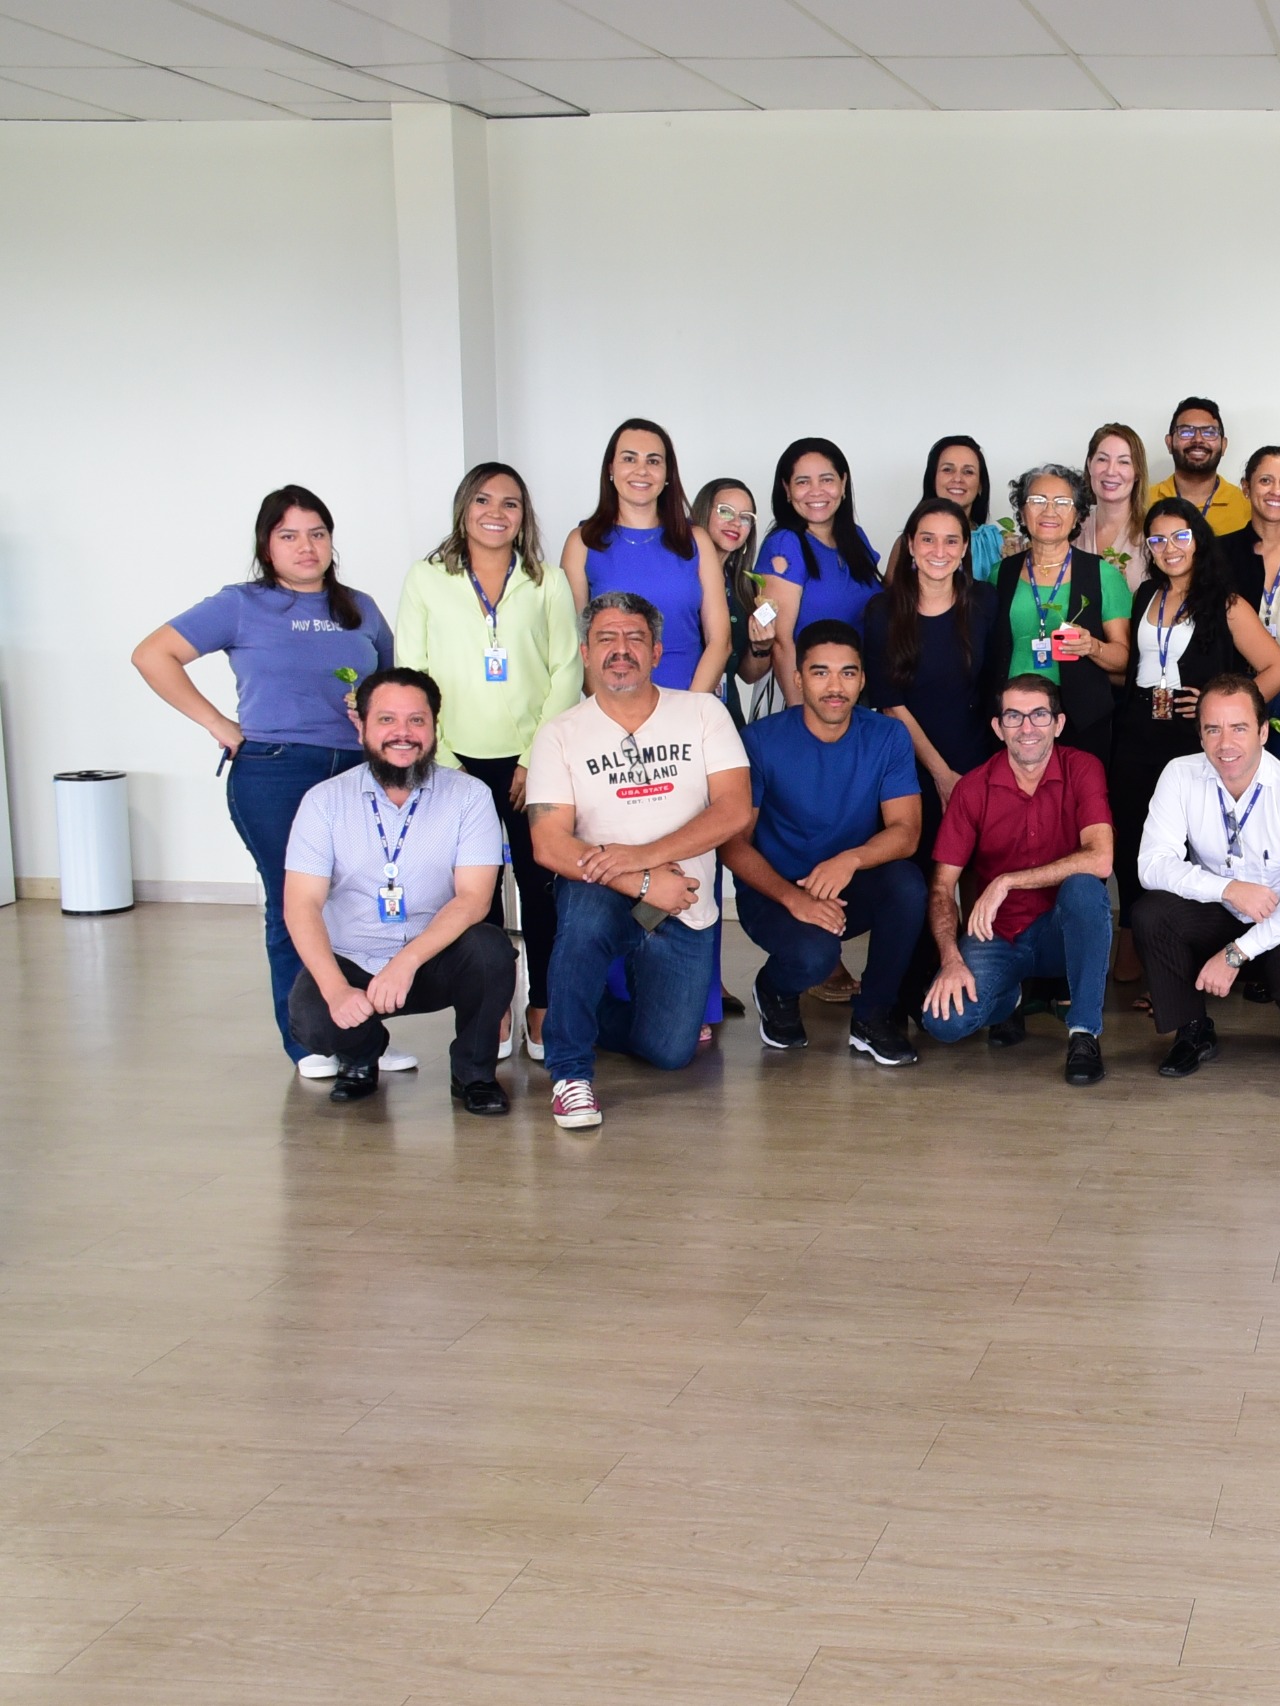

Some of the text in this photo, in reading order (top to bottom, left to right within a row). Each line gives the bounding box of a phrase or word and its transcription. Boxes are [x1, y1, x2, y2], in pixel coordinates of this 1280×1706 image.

[291, 619, 310, 631] MUY
[586, 744, 692, 775] BALTMORE
[609, 764, 678, 784] MARYAND
[643, 786, 669, 794] STATE
